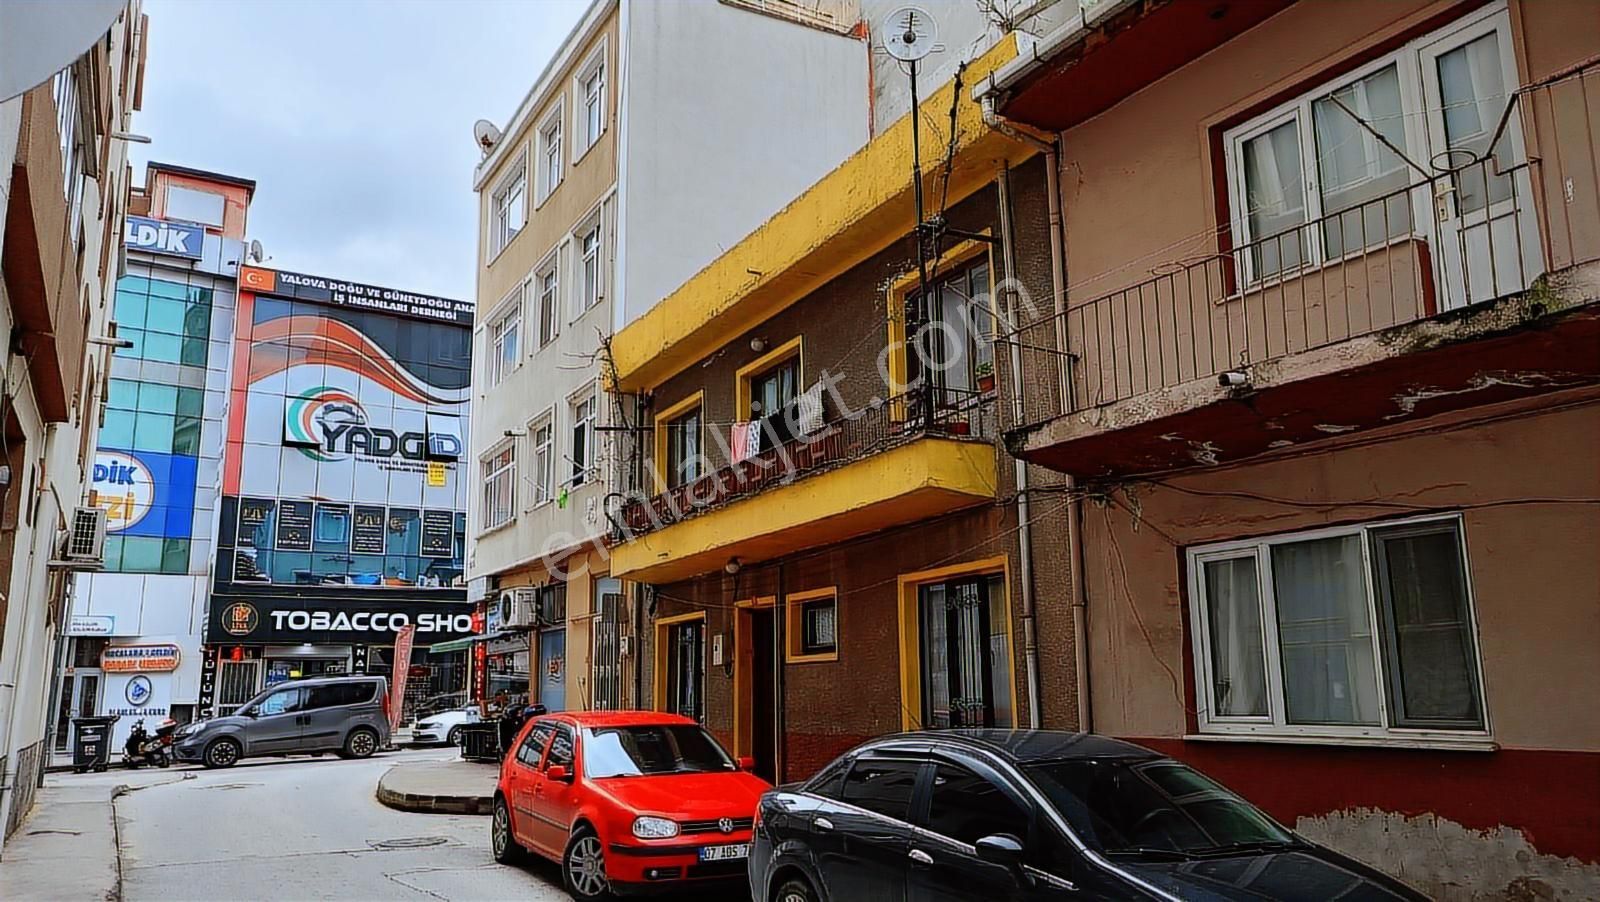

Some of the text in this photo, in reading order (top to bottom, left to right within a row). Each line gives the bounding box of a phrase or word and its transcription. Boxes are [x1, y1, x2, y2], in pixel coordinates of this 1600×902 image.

[279, 272, 326, 289] YALOVA
[328, 281, 364, 296] DOĞU
[366, 288, 381, 299] VE
[96, 491, 135, 520] Zİ
[270, 610, 410, 631] TOBACCO
[704, 848, 717, 860] 07
